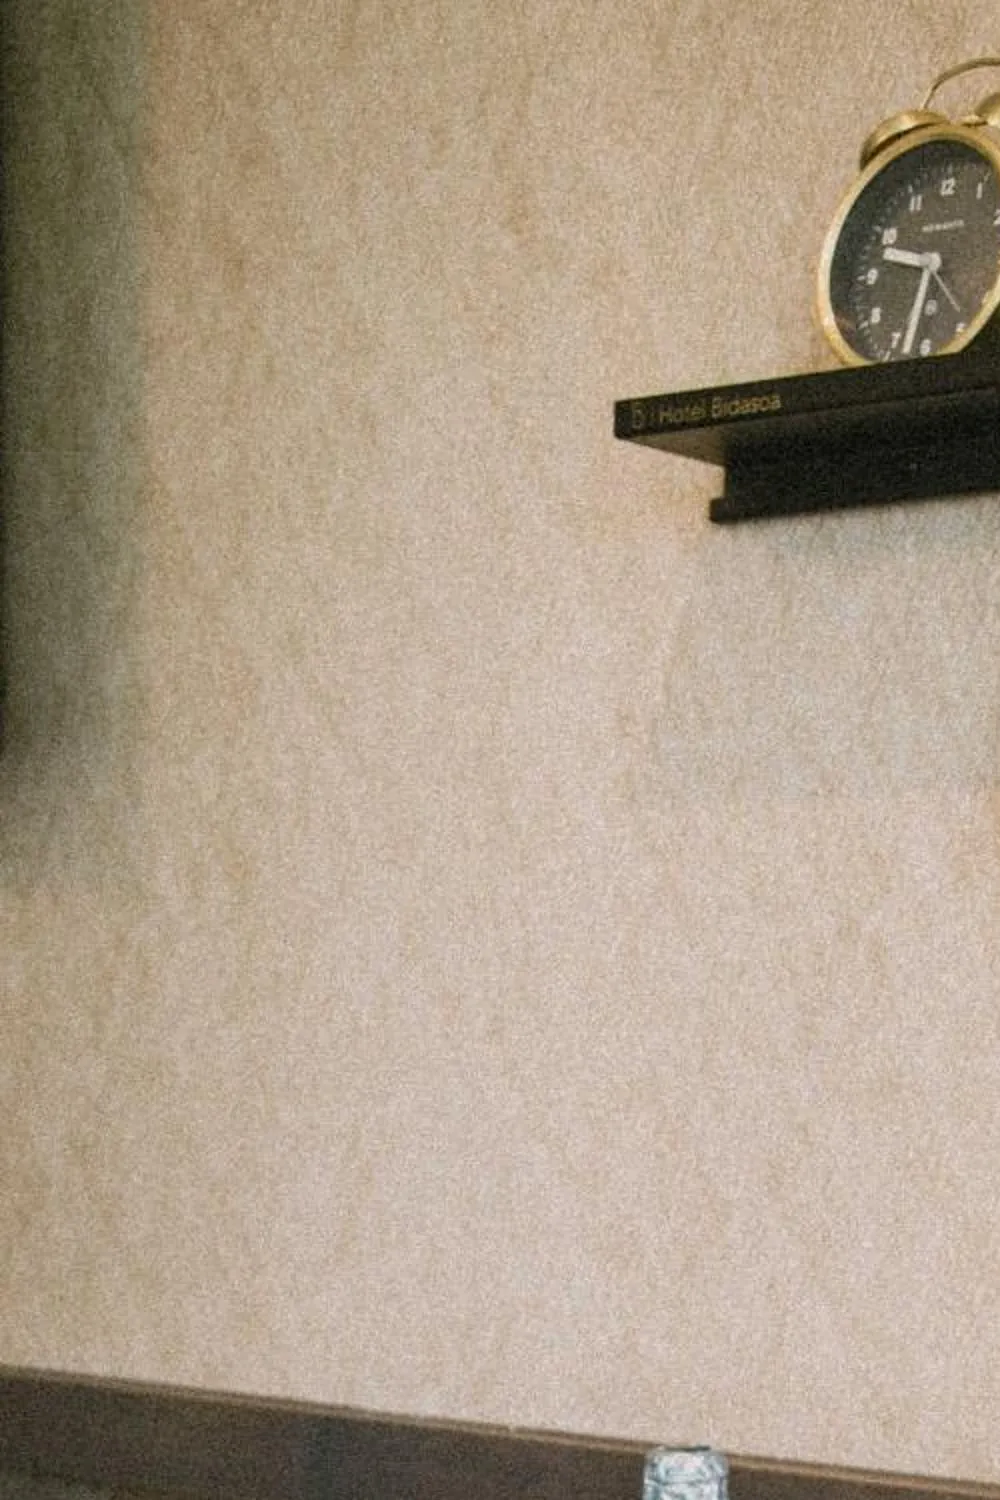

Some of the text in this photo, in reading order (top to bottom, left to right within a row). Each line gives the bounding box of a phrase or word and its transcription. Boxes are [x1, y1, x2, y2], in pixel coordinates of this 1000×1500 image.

[940, 178, 956, 197] 12
[975, 183, 984, 200] 1
[909, 195, 923, 212] 11
[882, 228, 898, 245] 10
[867, 268, 879, 285] 9
[871, 307, 882, 324] 8
[891, 332, 902, 349] 7
[919, 338, 932, 357] 6
